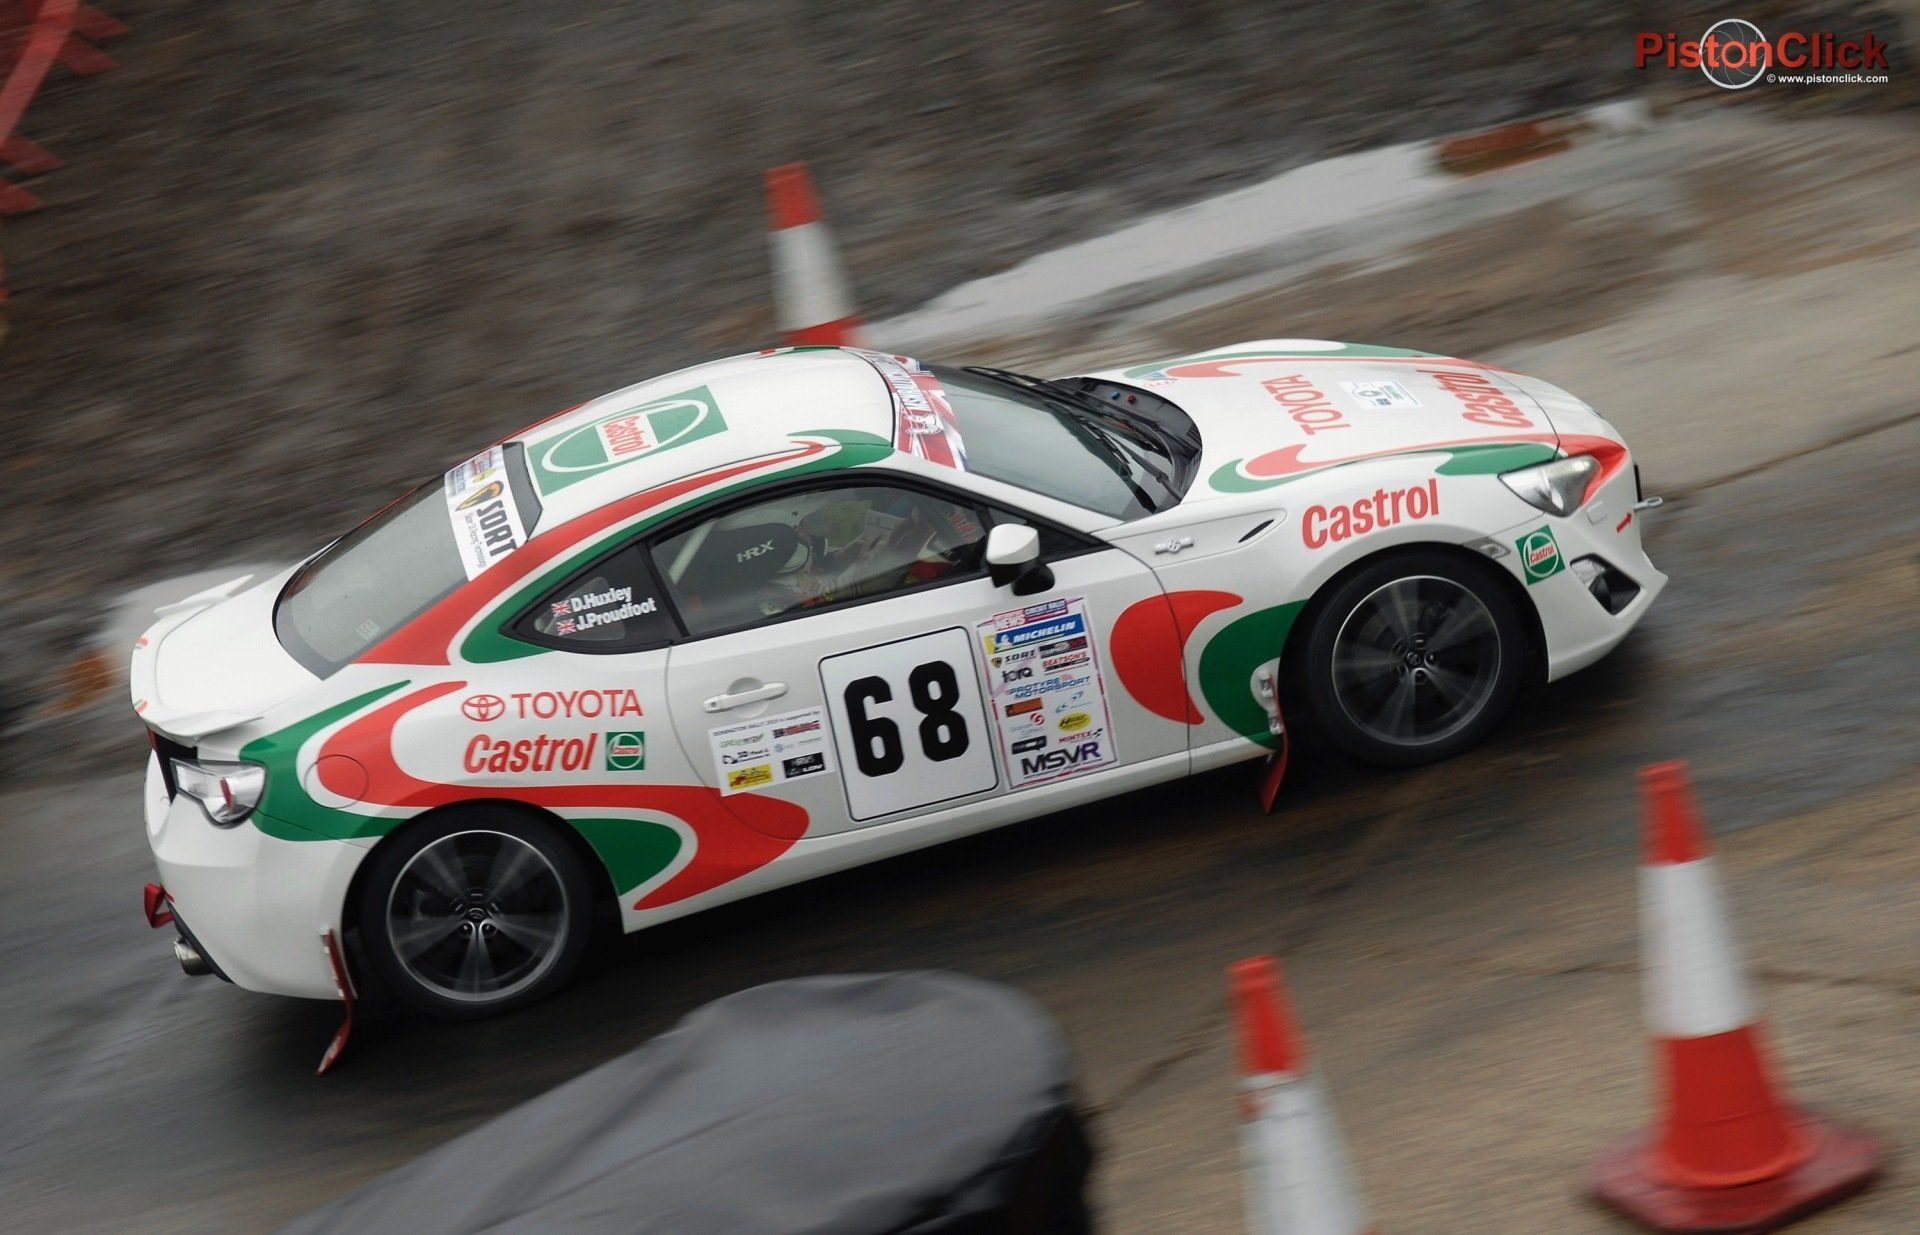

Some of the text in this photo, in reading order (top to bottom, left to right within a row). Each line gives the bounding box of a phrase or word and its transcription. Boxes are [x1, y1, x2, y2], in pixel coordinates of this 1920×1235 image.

[1260, 374, 1351, 435] TOYOTA
[1416, 370, 1534, 428] Castrol
[603, 415, 651, 456] Castrol
[477, 500, 517, 557] SORT
[1302, 478, 1439, 549] Castrol
[736, 539, 775, 564] HRX
[1530, 544, 1555, 564] Castrol
[570, 587, 632, 613] D.Huxley
[576, 597, 657, 631] J.Proudfoot
[1013, 621, 1076, 643] MICHELIN
[1005, 650, 1036, 663] SORT
[511, 689, 644, 719] TOYOTA
[1009, 678, 1060, 696] PROTYRE
[1014, 676, 1091, 700] MOTORSPORT
[844, 660, 969, 777] 68
[464, 733, 598, 774] Castrol
[1023, 741, 1101, 776] MSVR
